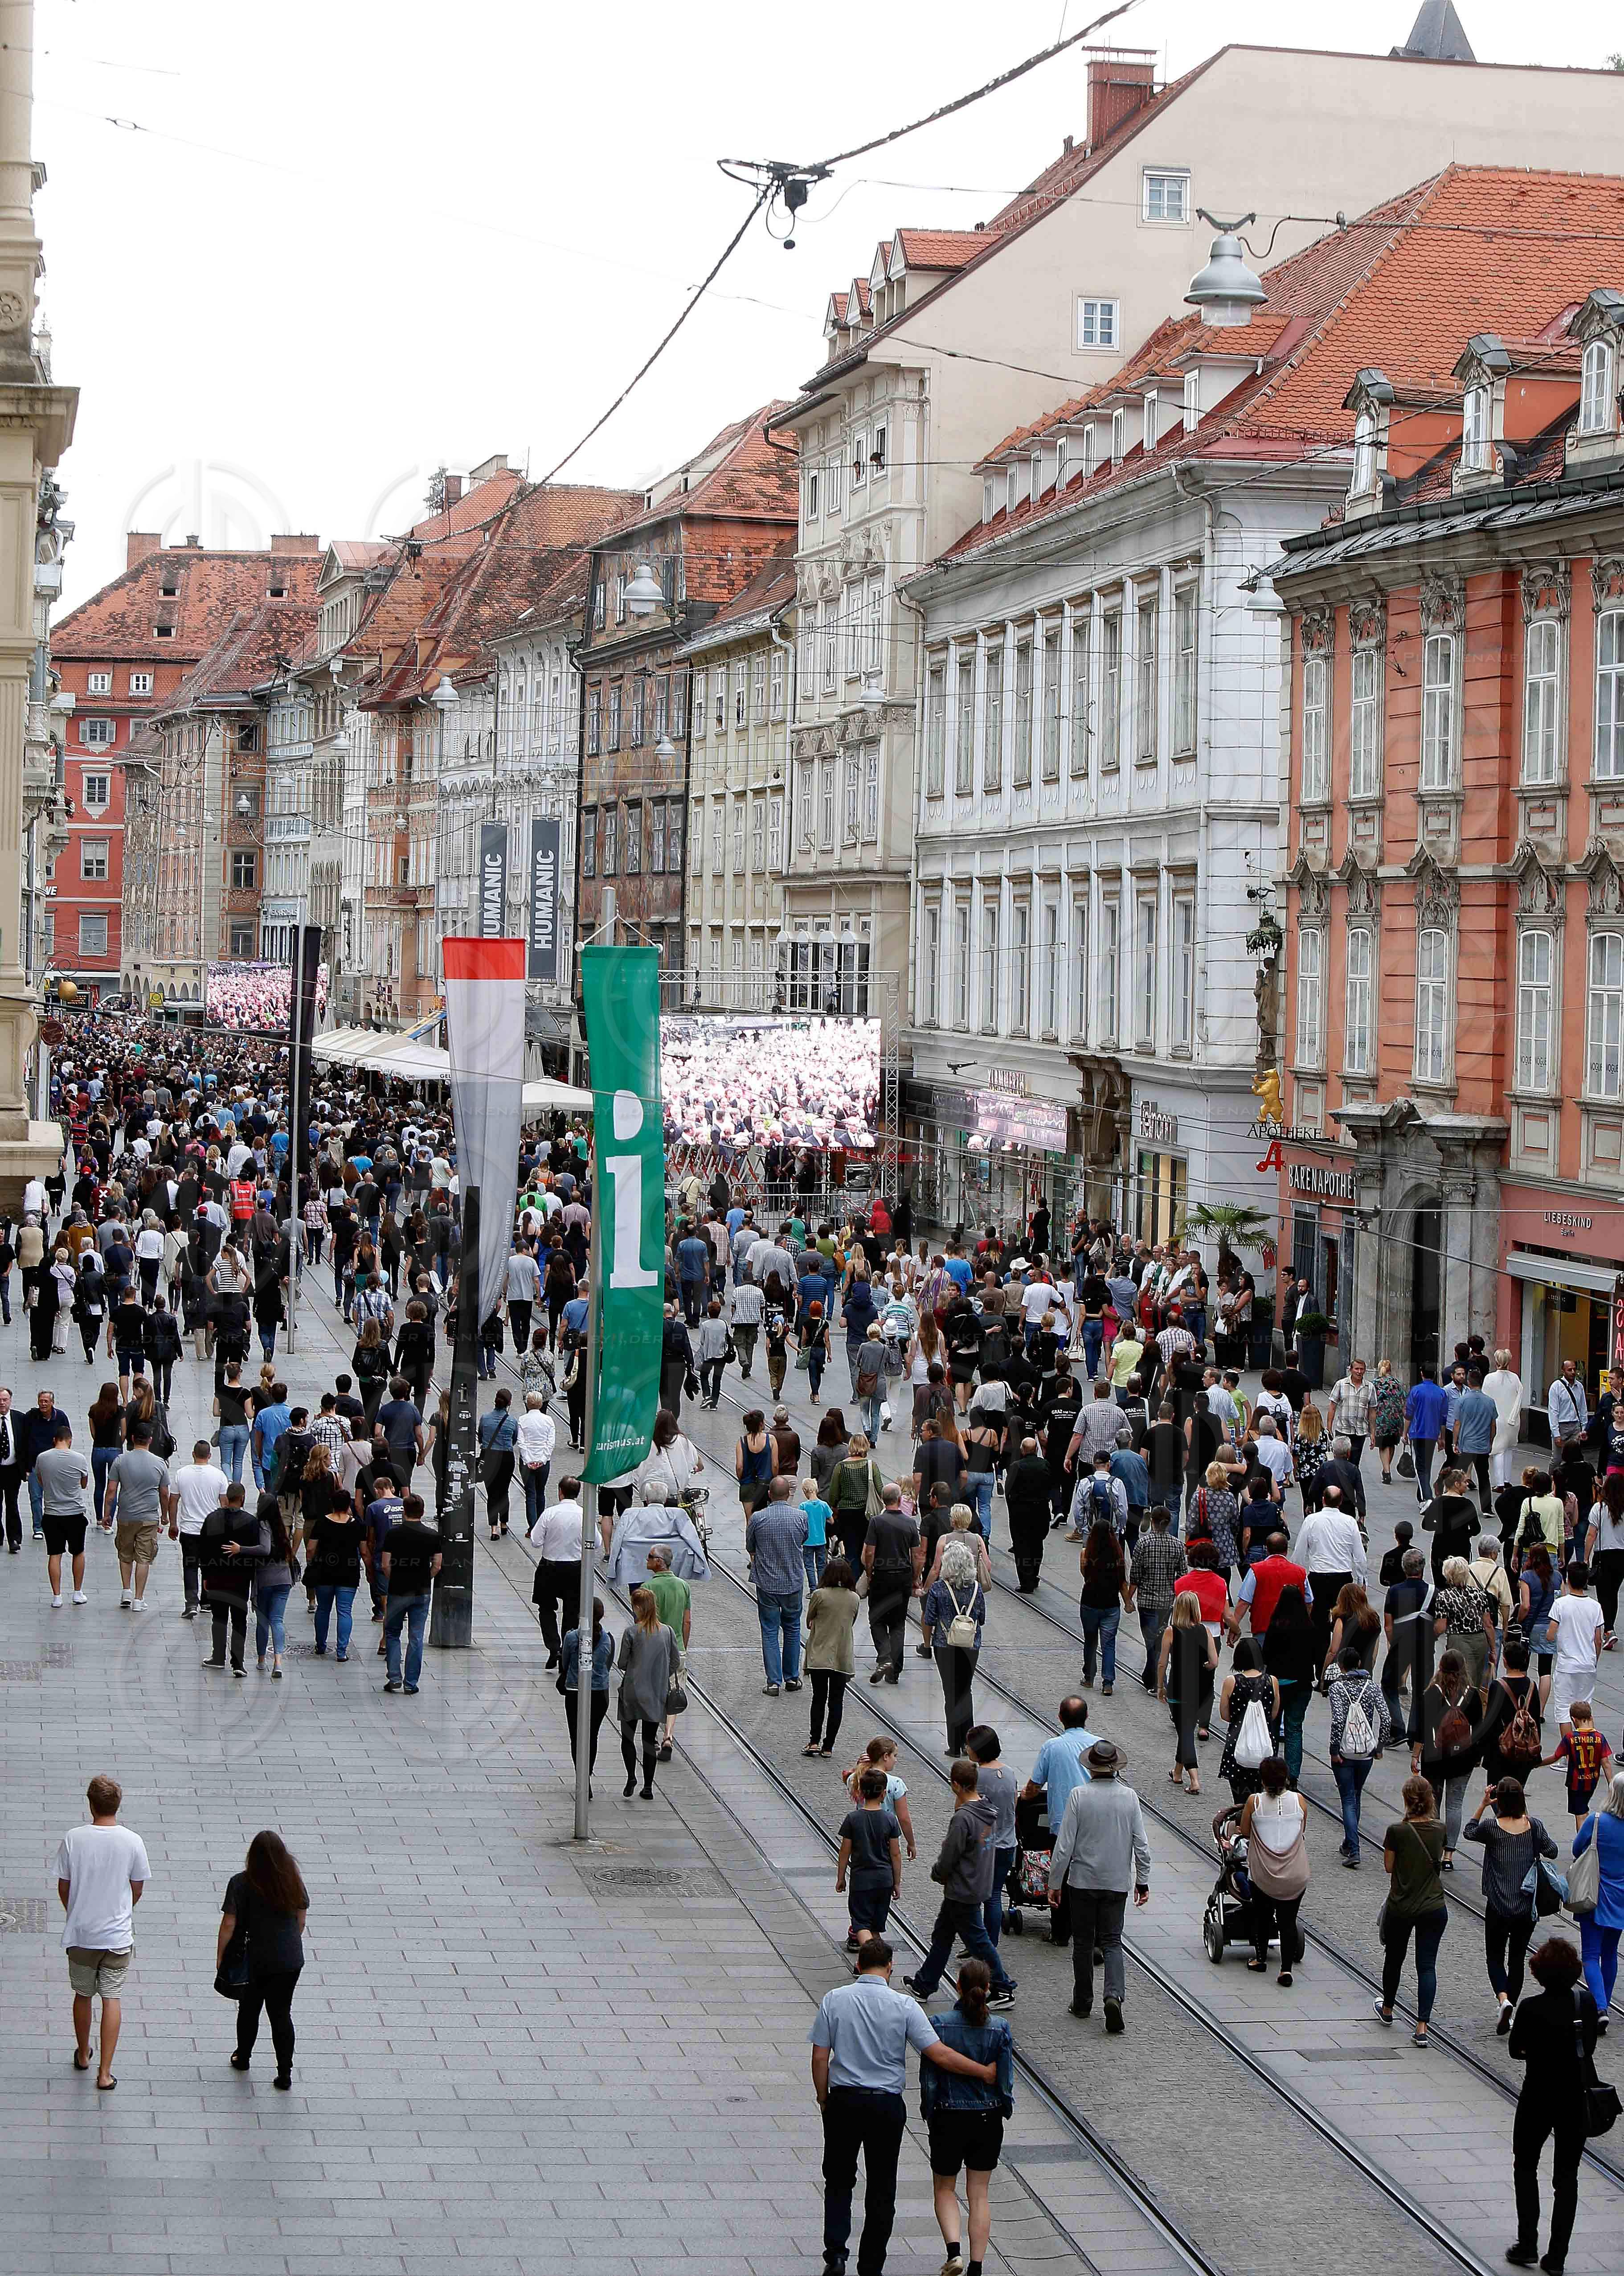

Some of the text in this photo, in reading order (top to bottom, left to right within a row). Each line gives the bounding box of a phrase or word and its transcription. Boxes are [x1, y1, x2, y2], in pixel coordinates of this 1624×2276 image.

[534, 849, 554, 949] HUMANIC
[1520, 1055, 1532, 1066] VOGUE
[1534, 1057, 1547, 1067] VOGUE
[1590, 1062, 1603, 1073] VOGUE
[1606, 1063, 1619, 1074] VOGUE
[1248, 1124, 1322, 1139] APOTHEKE
[502, 1199, 513, 1246] Joanneum
[1543, 1211, 1592, 1230] LIEBESKIND
[1570, 1736, 1594, 1744] NEYMAR
[1576, 1745, 1595, 1769] 11
